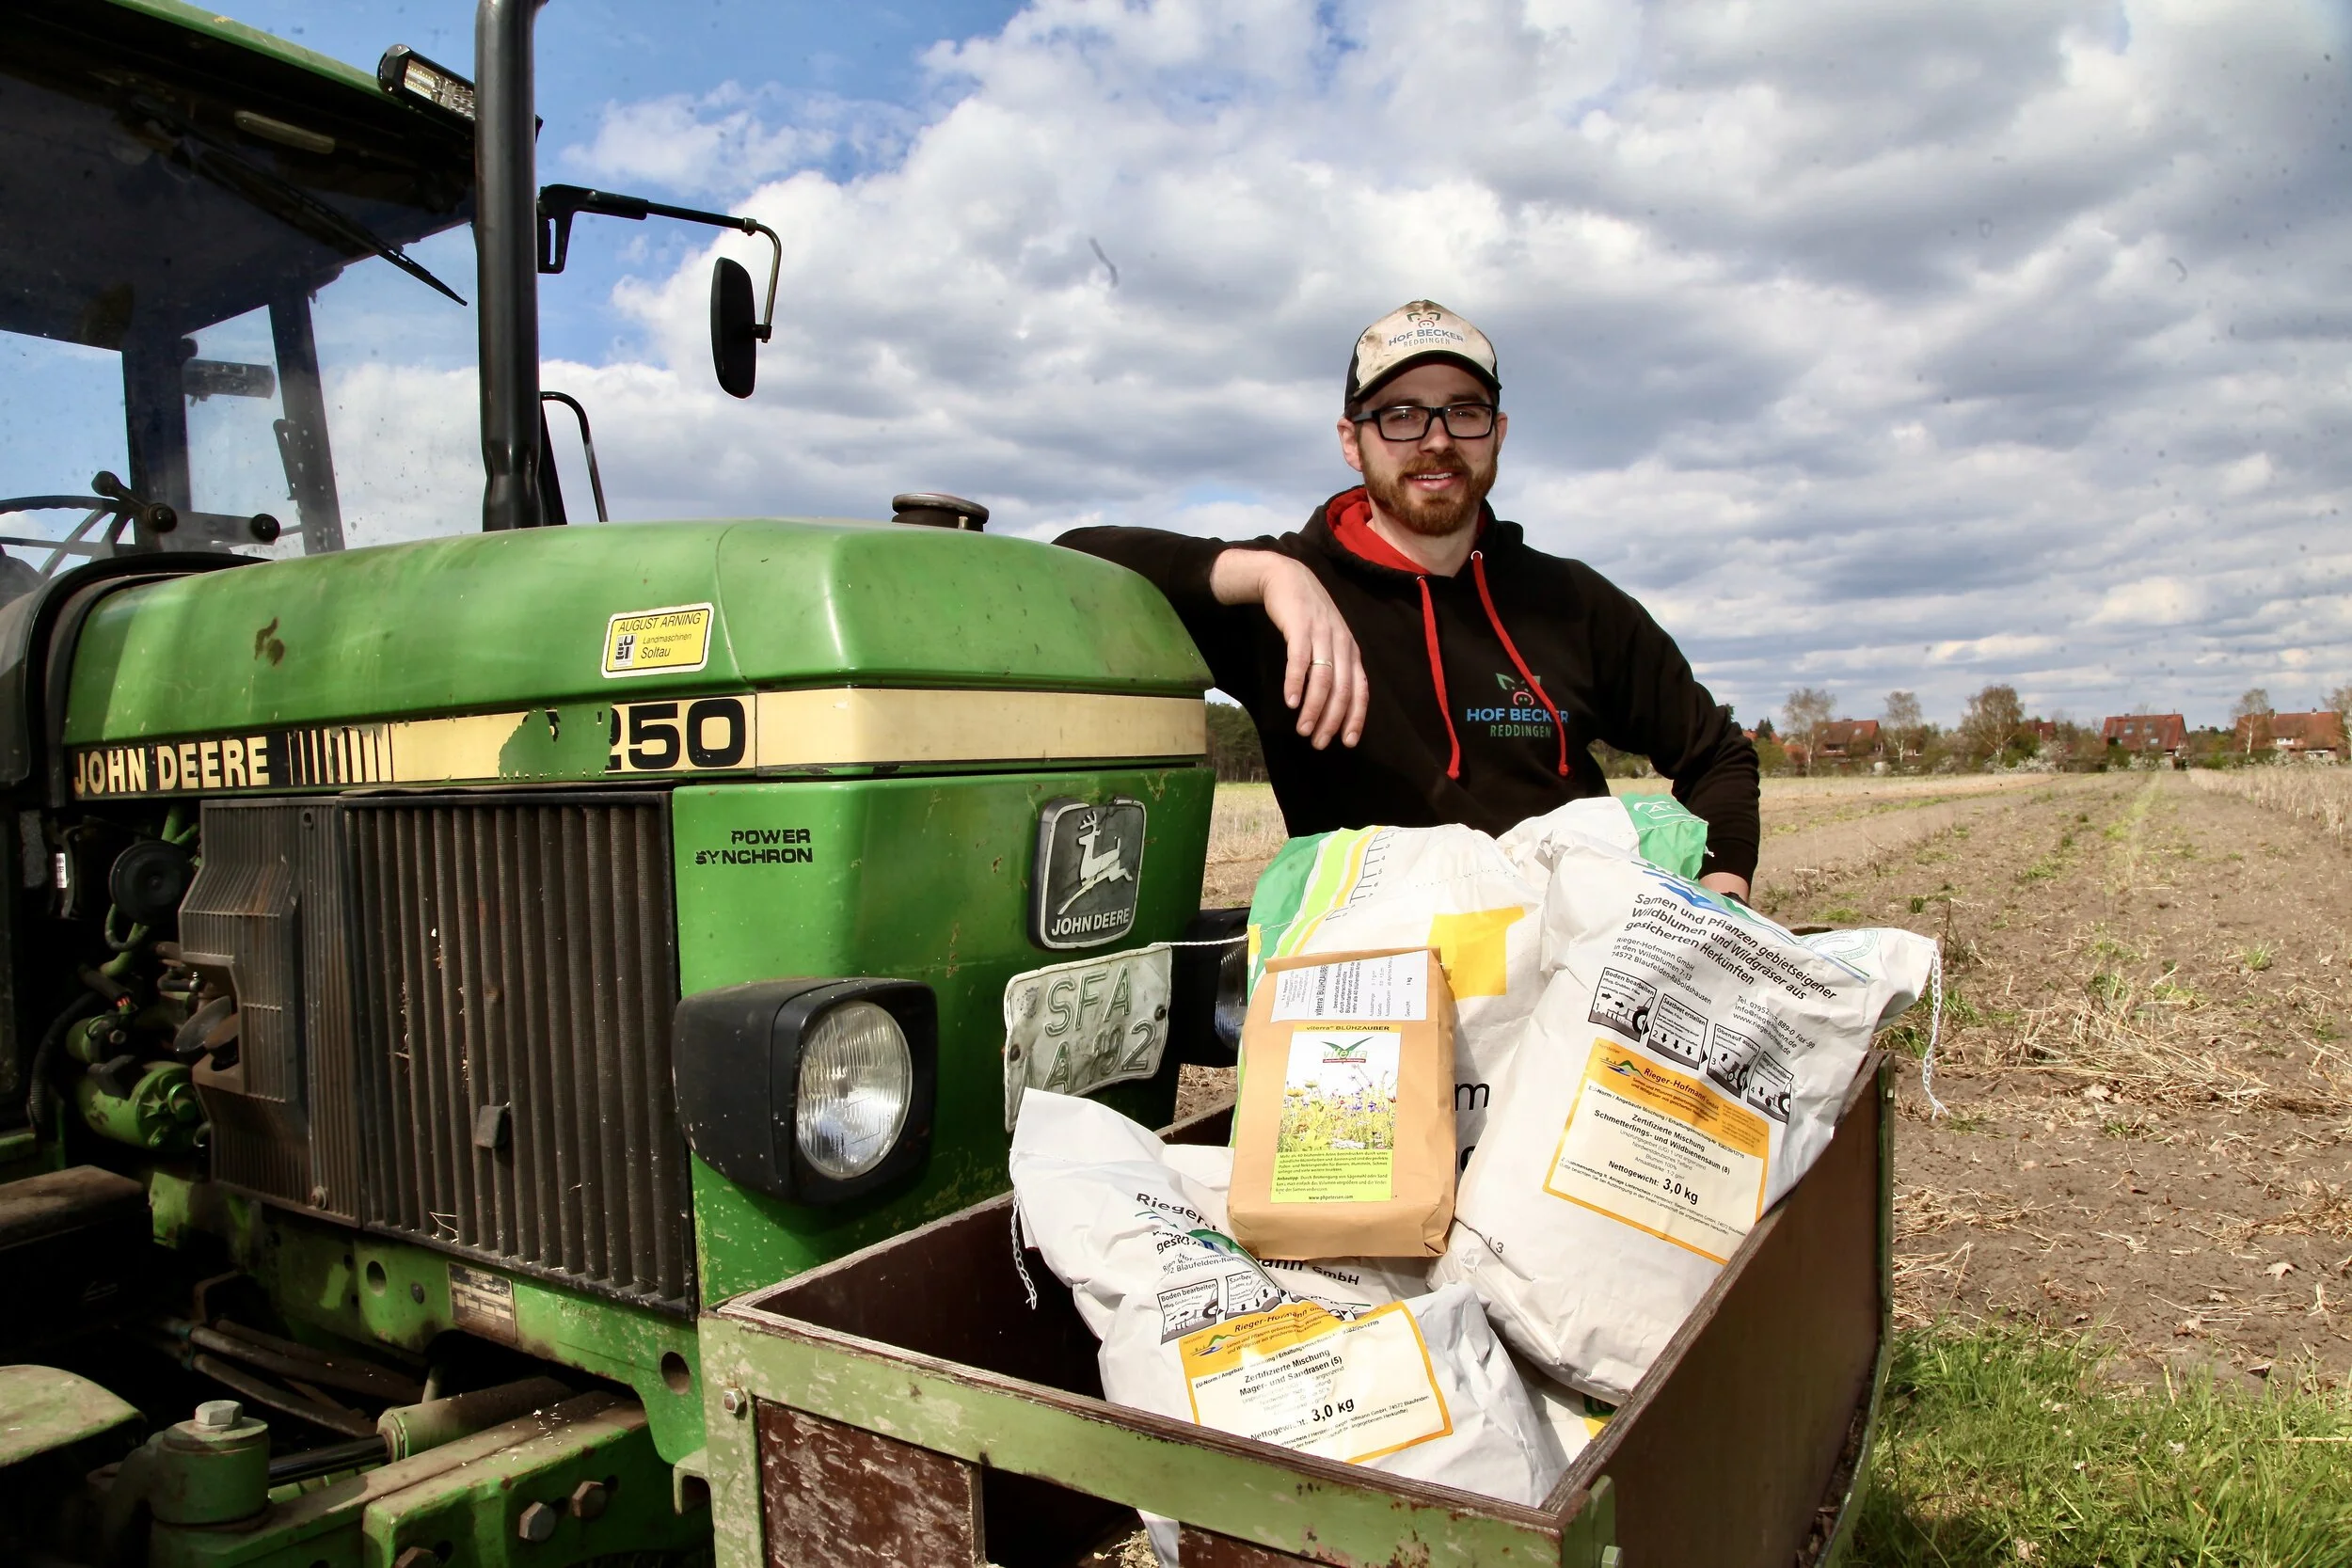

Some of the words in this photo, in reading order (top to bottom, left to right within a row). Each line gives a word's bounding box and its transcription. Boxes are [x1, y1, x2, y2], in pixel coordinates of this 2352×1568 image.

[1388, 331, 1413, 347] HOF
[1416, 329, 1464, 343] BECKER
[1404, 338, 1451, 348] REDDINGEN
[618, 617, 660, 632] AUGUST
[660, 612, 701, 628] ARNING
[643, 632, 692, 645] Landmaschinen
[641, 646, 672, 659] Soltau
[1467, 708, 1505, 721] HOF
[1509, 707, 1569, 723] BECKR
[1489, 724, 1551, 738] REDDINGEN
[73, 748, 147, 795] JOHN
[156, 736, 270, 791] DEERE
[731, 828, 811, 845] POWER
[695, 847, 814, 865] SYNCHRON
[1051, 915, 1092, 937] JOHN
[1093, 907, 1130, 931] DEERE
[1616, 937, 1676, 960] Rieger-Hofmann
[1676, 956, 1695, 972] GmbH
[1624, 921, 1700, 948] gesicherten
[1699, 942, 1755, 985] Herkünften
[1631, 907, 1708, 937] Wildblumen
[1710, 932, 1734, 949] und
[1731, 943, 1788, 986] Wildgräser
[1785, 984, 1807, 1000] aus
[1635, 894, 1678, 911] Samen
[1680, 908, 1707, 925] und
[1707, 918, 1758, 948] Pflanzen
[1756, 946, 1837, 999] gebietseigener
[1622, 944, 1637, 954] den
[1638, 948, 1679, 974] Wildblumen
[1678, 969, 1692, 981] 7-13
[1605, 971, 1626, 980] Boden
[1625, 977, 1655, 996] bearbeiten
[1611, 951, 1633, 961] 74572
[1633, 956, 1712, 1005] Blaufelden-Raboldshausen
[1044, 964, 1132, 1037] SFA
[1662, 997, 1685, 1014] Saatbeet
[1684, 1011, 1706, 1026] erstellen
[1737, 995, 1748, 1006] Tel.
[1795, 1034, 1806, 1044] Fax
[1716, 1027, 1742, 1042] Obenauf
[1323, 1048, 1368, 1059] viterra
[1644, 1068, 1706, 1101] Rieger-Hofmann
[1706, 1099, 1720, 1111] GmbH
[1614, 1096, 1642, 1110] Angebaute
[1642, 1106, 1665, 1121] Mischung
[1594, 1109, 1653, 1137] Schmetterlings-
[1654, 1134, 1669, 1145] und
[1669, 1139, 1721, 1170] Wildbienensaum
[1722, 1165, 1730, 1176] (8)
[1619, 1129, 1658, 1149] Ursprungsgebiet
[1658, 1146, 1669, 1154] (UG)
[1631, 1114, 1673, 1136] Zertifizierte
[1673, 1131, 1706, 1153] Mischung
[1645, 1153, 1664, 1165] Blumen
[1665, 1161, 1677, 1170] 100%
[1608, 1160, 1660, 1187] Nettogewicht:
[1662, 1179, 1682, 1195] 3,0
[1684, 1186, 1699, 1206] kg
[1624, 1182, 1651, 1196] Lieferschein
[1311, 1266, 1360, 1286] GmbH
[1161, 1292, 1182, 1302] Boden
[1181, 1282, 1216, 1296] bearbeiten
[1195, 1376, 1218, 1389] EU-Norm
[1221, 1366, 1244, 1378] Angebau
[1239, 1383, 1268, 1397] Mager-
[1269, 1375, 1286, 1386] und
[1287, 1360, 1329, 1381] Sandrasen
[1330, 1356, 1343, 1366] (5)
[1244, 1364, 1291, 1384] Zertifizierte
[1292, 1349, 1330, 1369] Mischung
[1311, 1404, 1333, 1422] 3,0
[1337, 1398, 1355, 1414] kg
